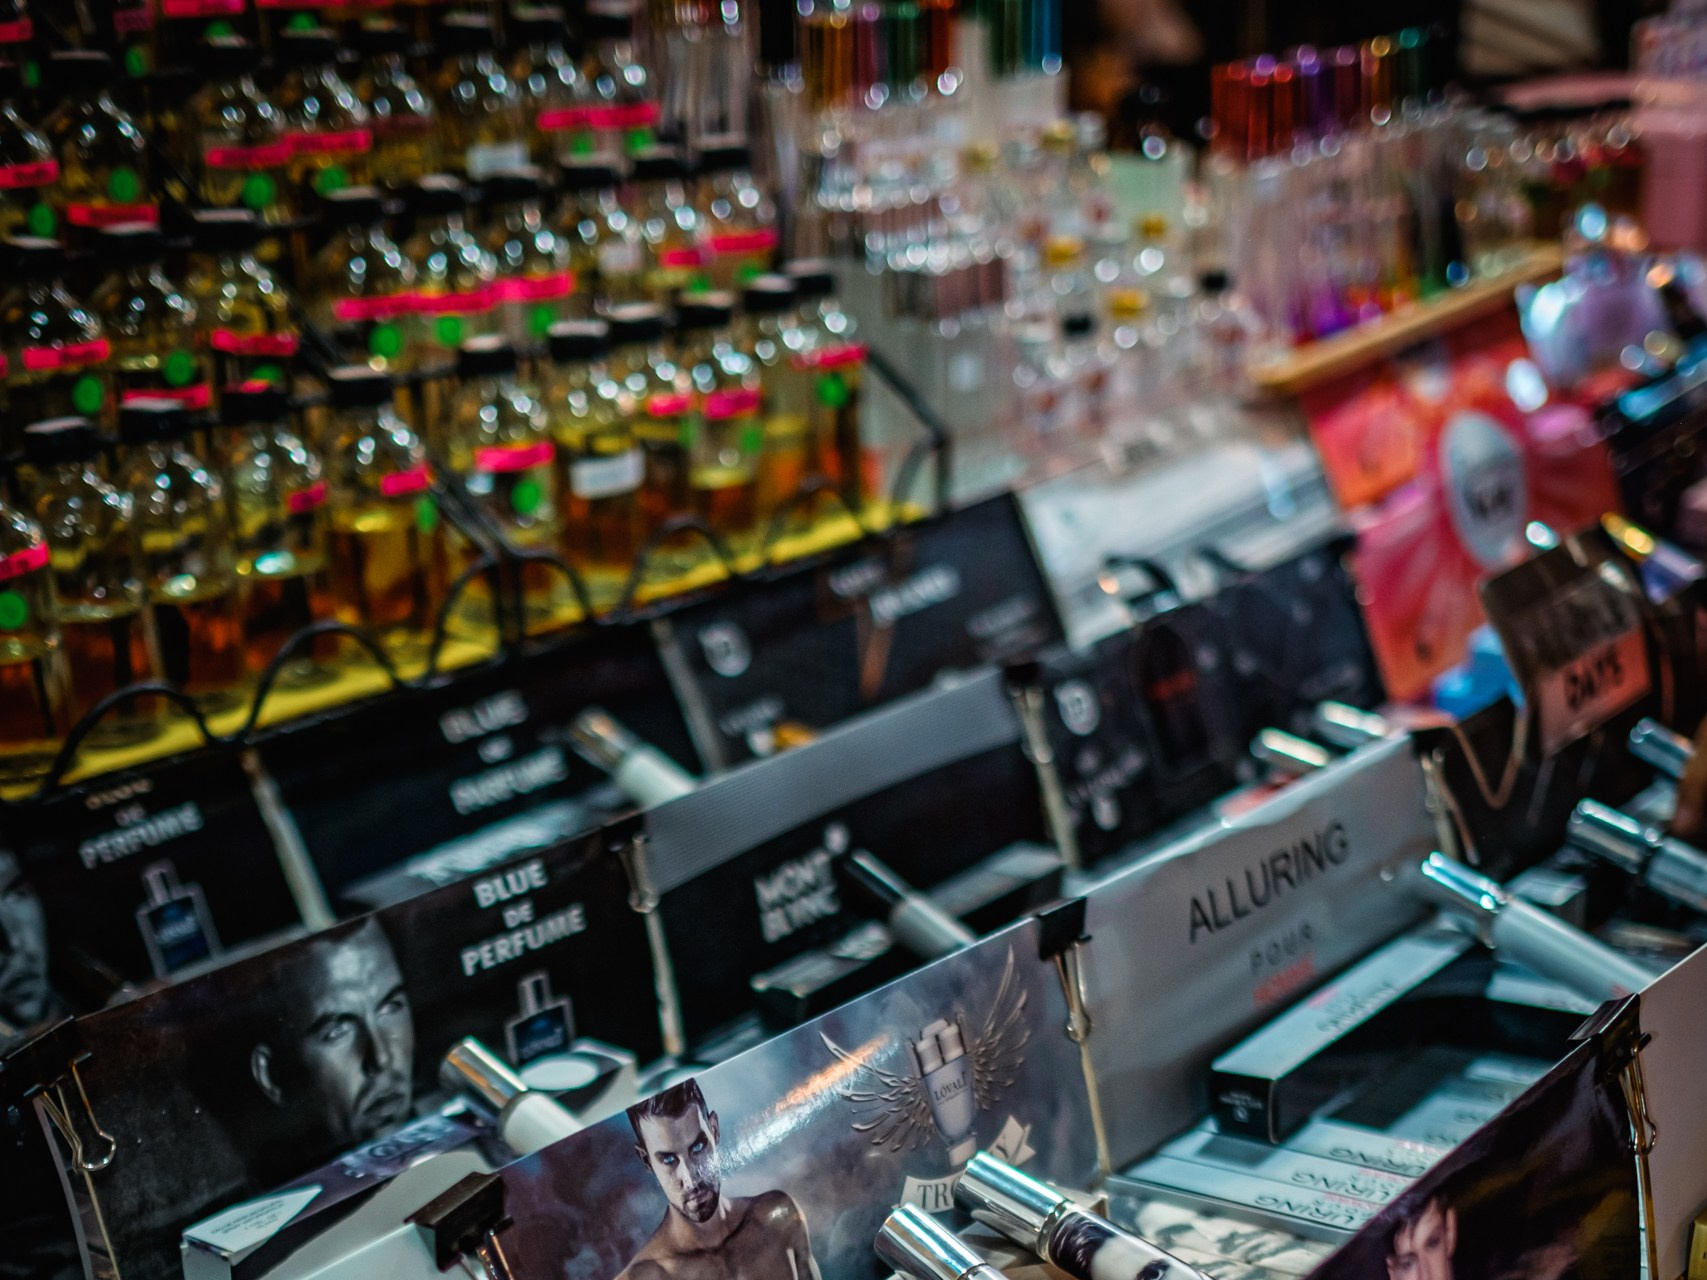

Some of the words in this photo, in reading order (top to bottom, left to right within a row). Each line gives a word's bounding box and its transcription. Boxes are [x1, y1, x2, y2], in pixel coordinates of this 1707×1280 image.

[473, 858, 548, 909] BLUE
[1189, 819, 1348, 944] ALLURING
[461, 902, 587, 976] PERFUME
[503, 900, 534, 929] DE
